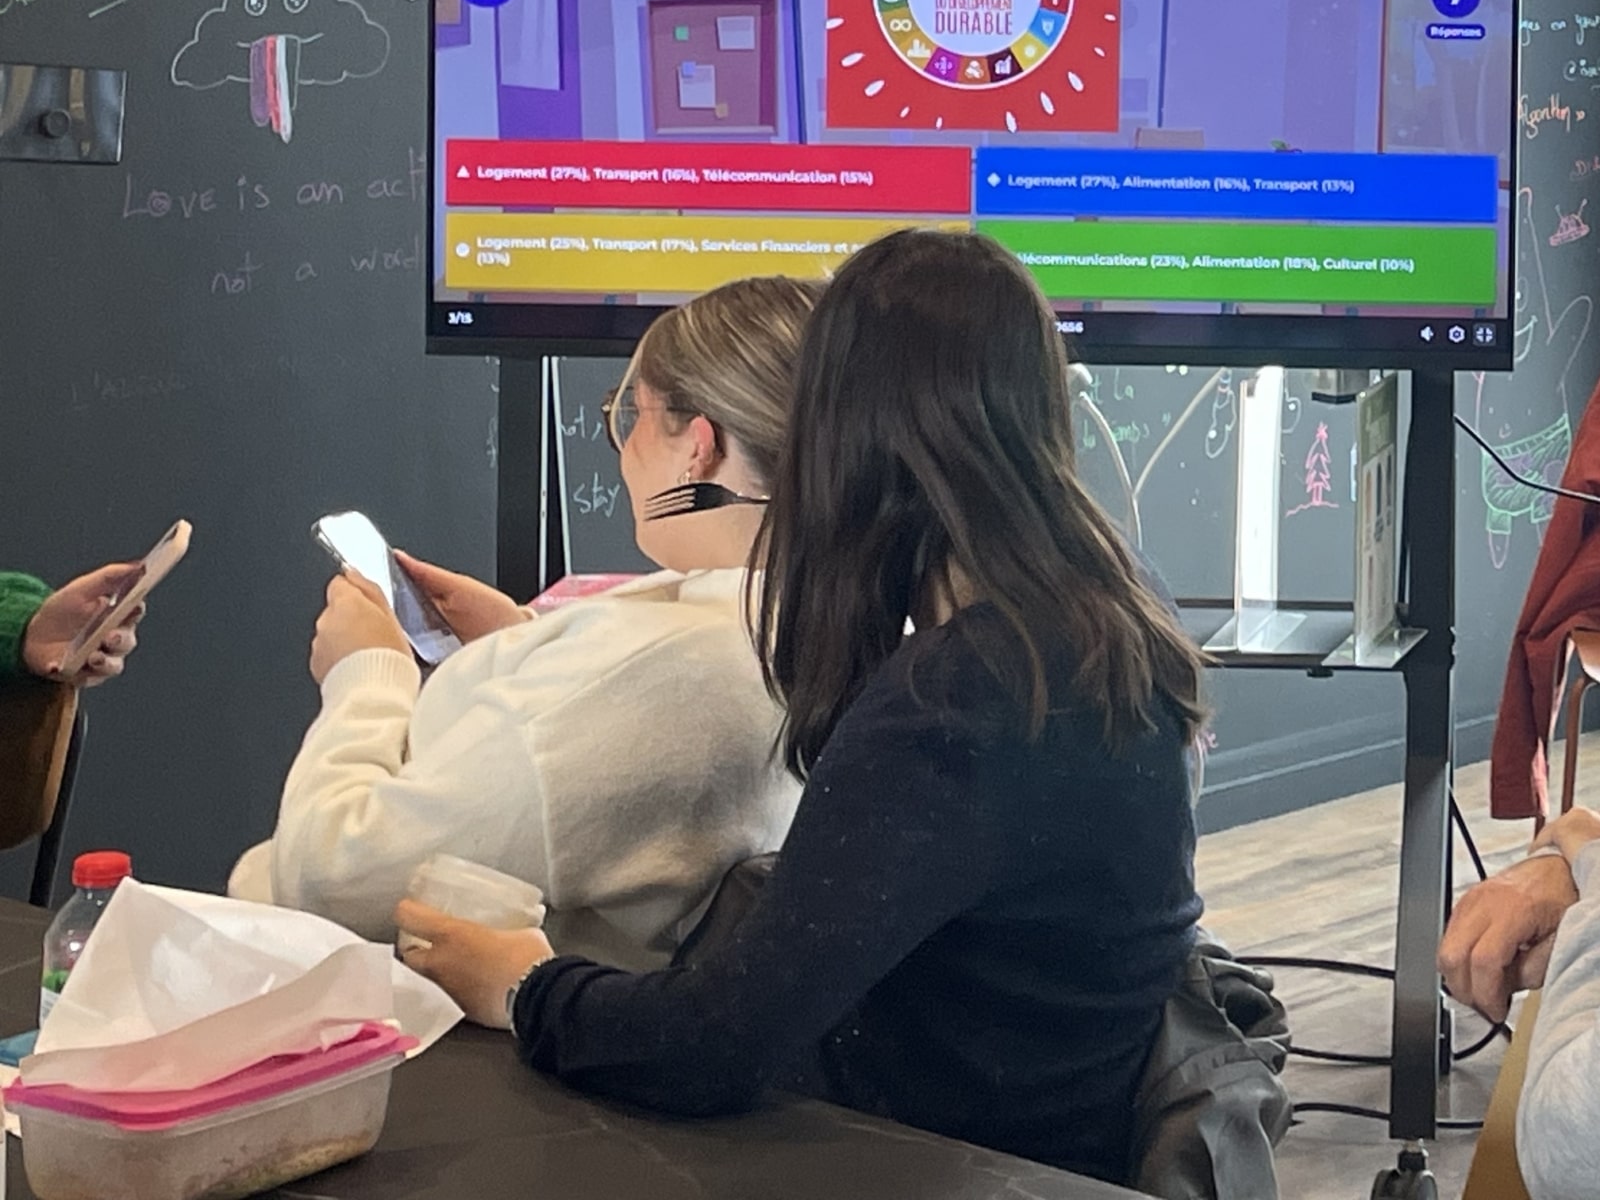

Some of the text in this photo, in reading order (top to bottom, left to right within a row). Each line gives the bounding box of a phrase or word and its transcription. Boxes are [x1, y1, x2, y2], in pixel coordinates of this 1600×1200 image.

[935, 11, 1013, 36] DURABLE
[477, 166, 547, 180] Logement
[551, 167, 590, 182] (27%),
[593, 167, 659, 183] Transport
[703, 168, 837, 185] Télécommunication
[1008, 173, 1077, 190] Logement
[1080, 174, 1120, 191] (27%),
[1123, 174, 1211, 191] Alimentation
[1253, 176, 1318, 194] Transport
[239, 175, 270, 211] is
[297, 181, 343, 204] an
[476, 237, 547, 250] Logement
[592, 238, 657, 253] Transport
[661, 239, 699, 254] (17%),
[701, 240, 758, 254] Services
[761, 240, 831, 254] Financiers
[834, 241, 848, 254] et
[211, 251, 263, 293] not
[296, 263, 317, 281] a
[1016, 252, 1147, 269] lécommunications
[1150, 253, 1188, 270] (23%),
[1192, 254, 1280, 271] Alimentation
[1322, 256, 1377, 272] Culturel
[1380, 257, 1414, 274] (10%)
